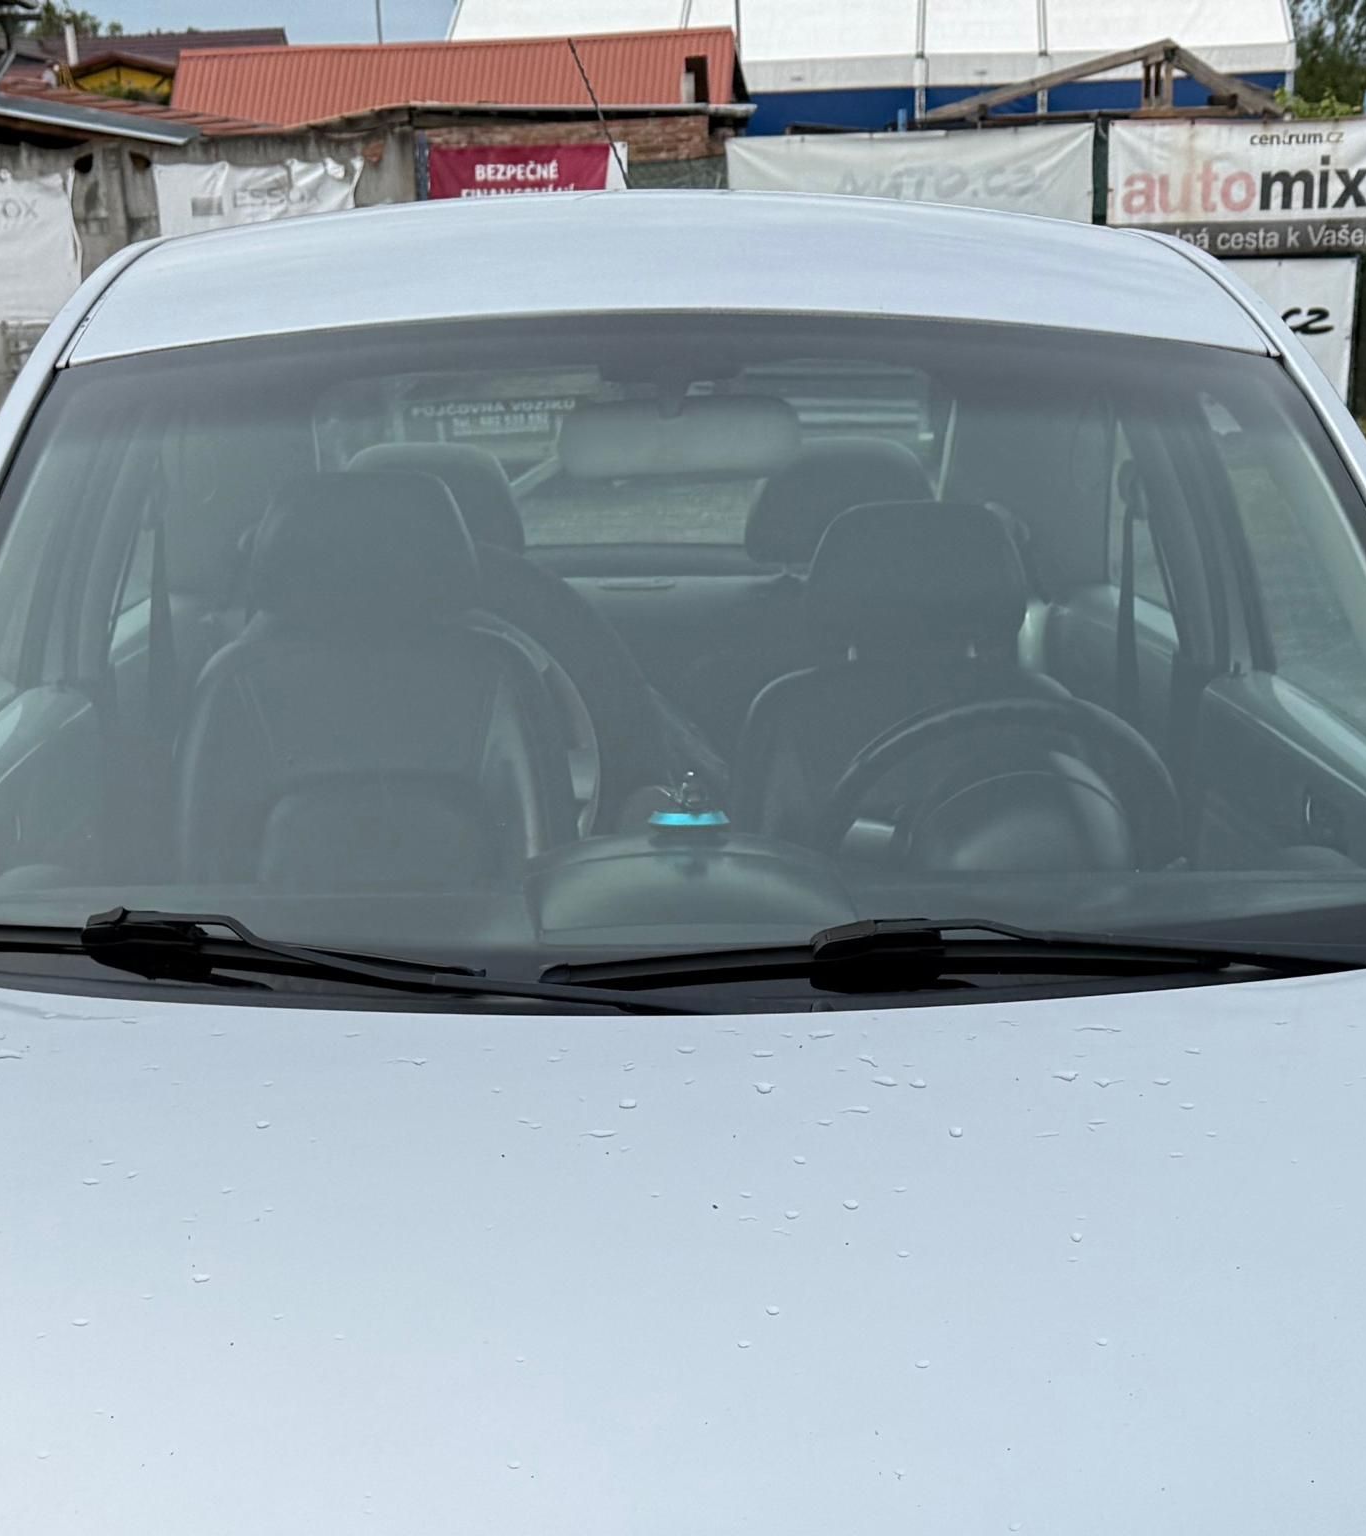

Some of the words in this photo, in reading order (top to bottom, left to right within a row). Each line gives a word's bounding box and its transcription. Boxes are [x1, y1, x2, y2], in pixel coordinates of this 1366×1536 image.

[475, 160, 559, 182] BEZPEČNÉ
[1217, 228, 1278, 249] cesta
[1286, 226, 1301, 248] k
